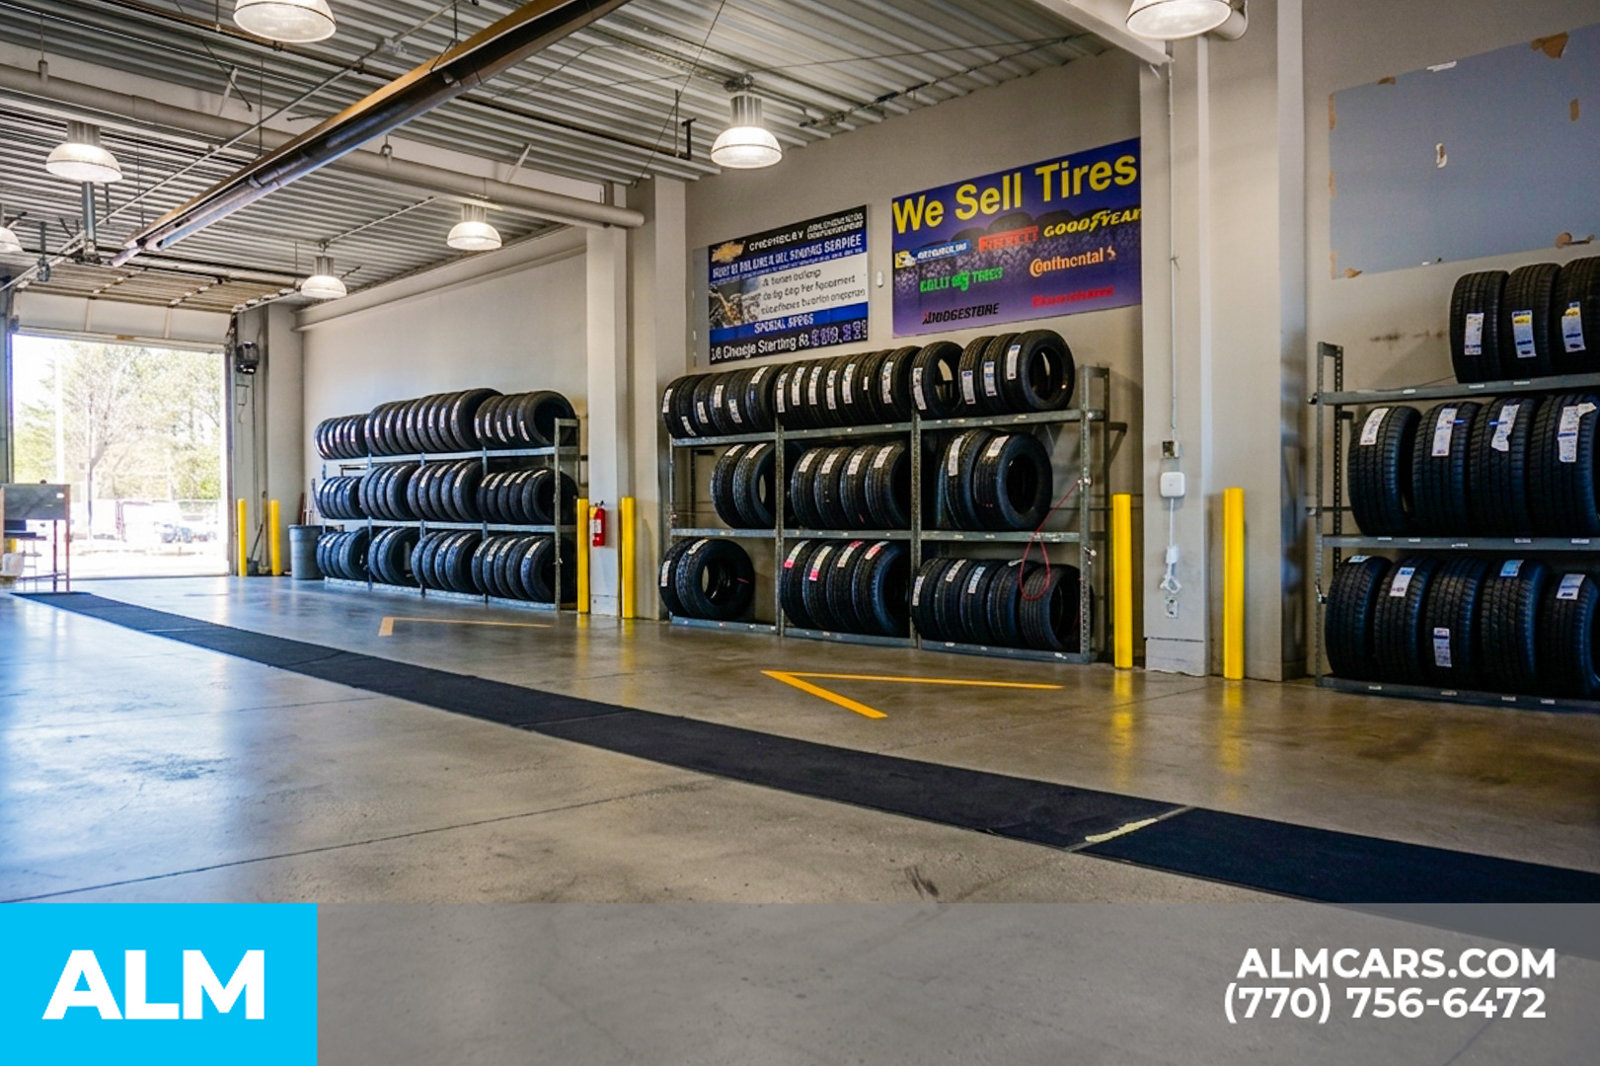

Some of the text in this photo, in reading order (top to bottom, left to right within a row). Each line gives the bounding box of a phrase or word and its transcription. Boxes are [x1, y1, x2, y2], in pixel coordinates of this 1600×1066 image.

[892, 195, 944, 234] We
[954, 171, 1022, 220] Sell
[1034, 154, 1138, 202] Tires
